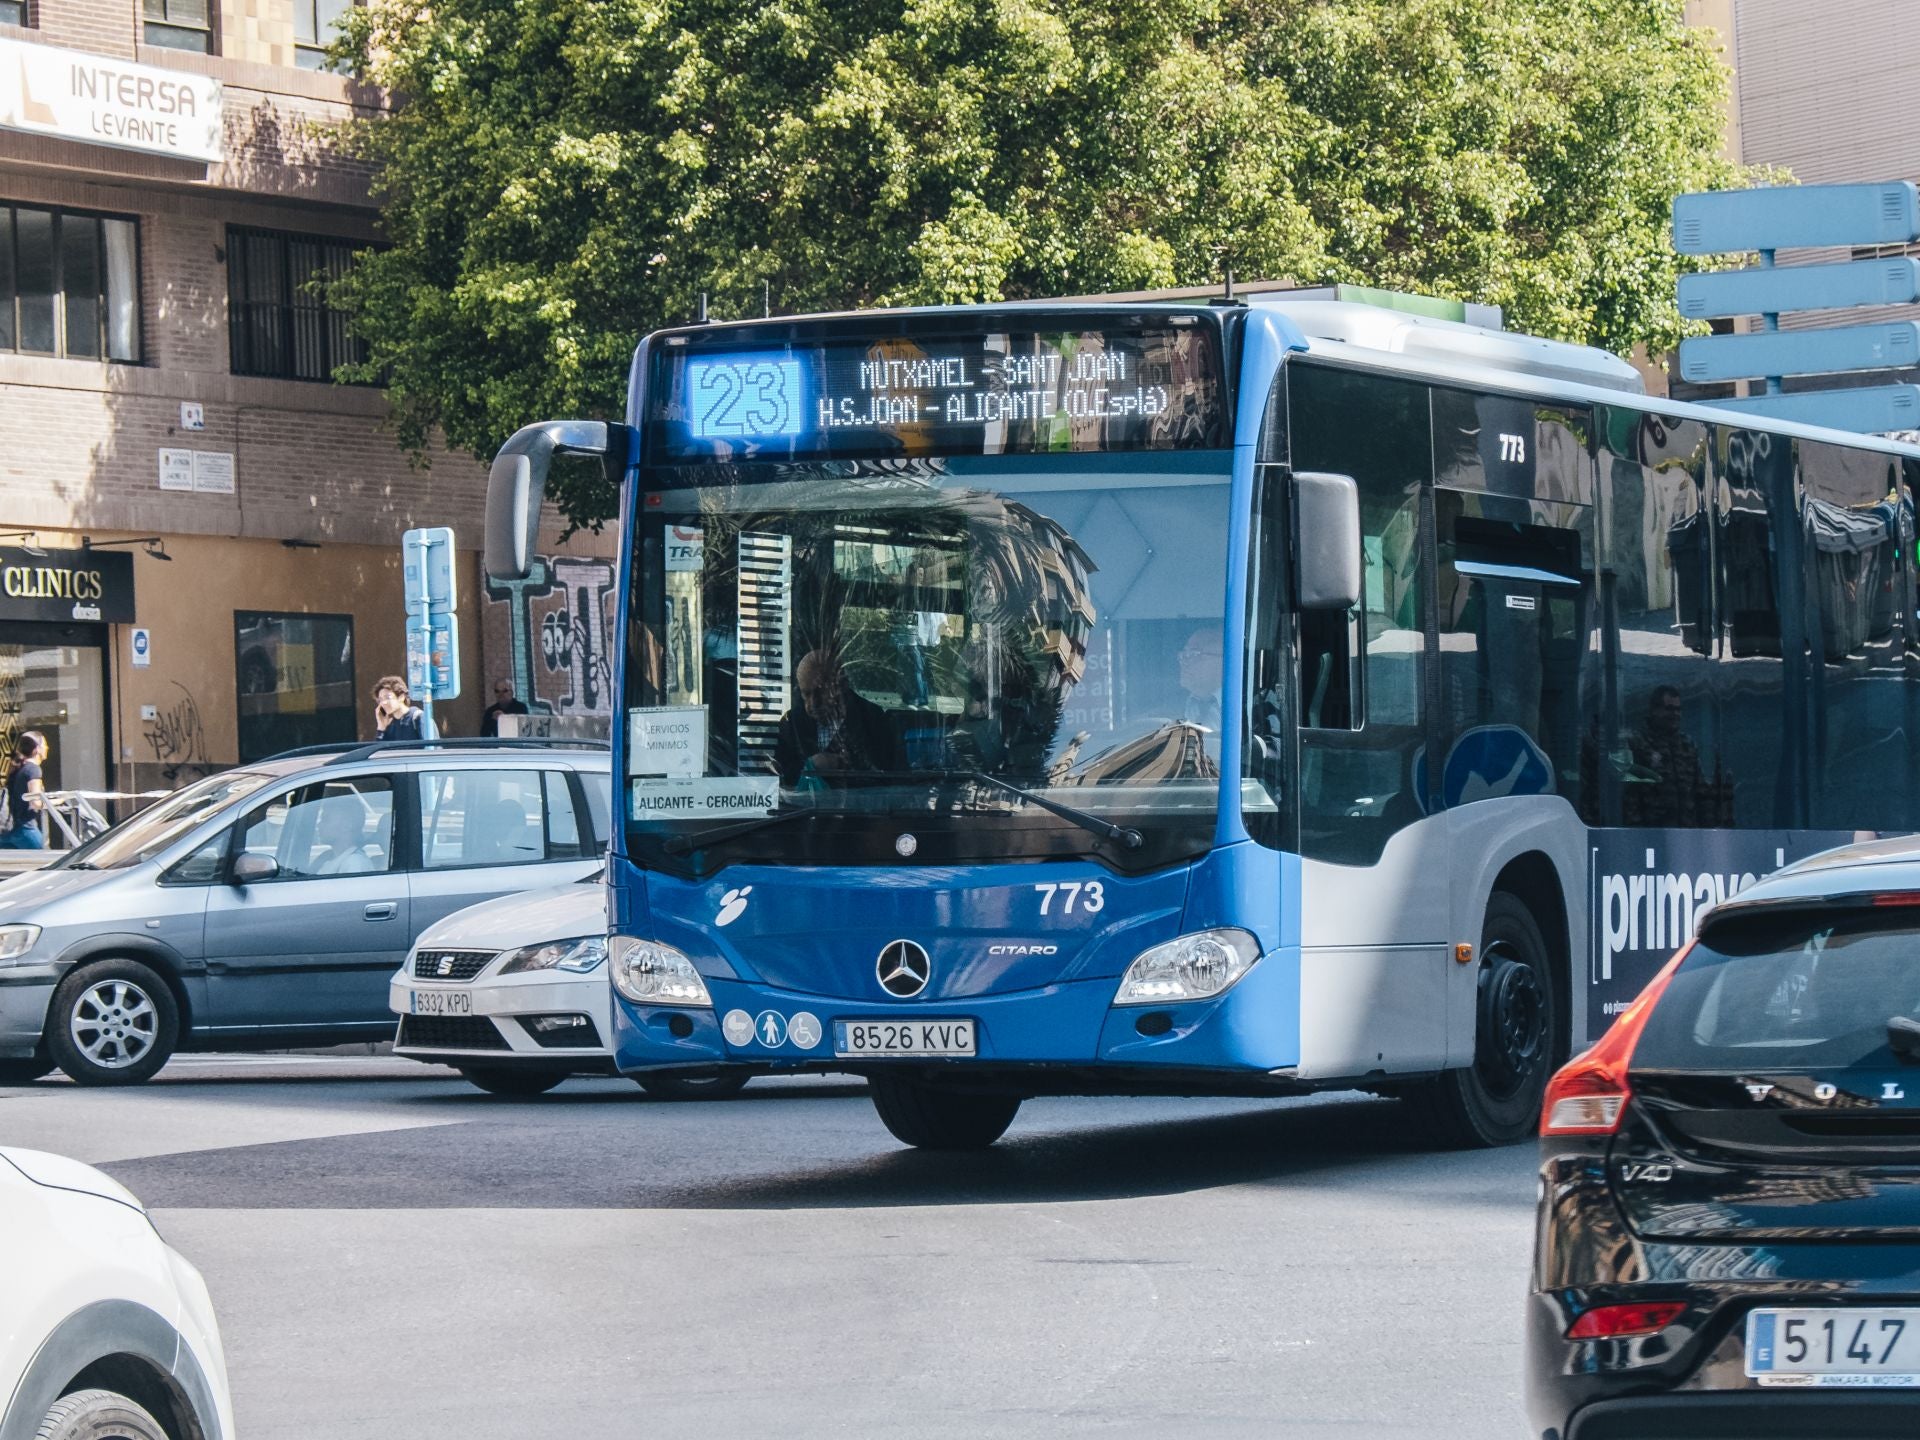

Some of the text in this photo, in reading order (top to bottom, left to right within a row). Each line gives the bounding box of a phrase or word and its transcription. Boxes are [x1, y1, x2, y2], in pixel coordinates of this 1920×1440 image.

[71, 64, 196, 118] INTERSA
[91, 113, 177, 146] LEVANTE
[860, 358, 974, 389] MUTXAMEL
[1002, 355, 1060, 384] SANT
[1068, 352, 1126, 381] JOAN
[700, 362, 790, 437] 23
[819, 395, 918, 426] H.S.JOAN
[946, 391, 1056, 421] ALICANTE
[1499, 432, 1525, 463] 773
[4, 566, 102, 599] CLINICS
[639, 796, 694, 809] ALICANTE
[706, 791, 772, 808] CERCANÍAS
[1034, 881, 1105, 915] 773
[988, 945, 1058, 955] CITARO
[417, 991, 470, 1012] 6332 KPD
[852, 1025, 969, 1049] 8526 KVC
[1622, 1164, 1673, 1182] V40
[1784, 1318, 1906, 1365] 5147
[1821, 1376, 1868, 1385] ANKARA
[1873, 1376, 1913, 1385] MOTOR
